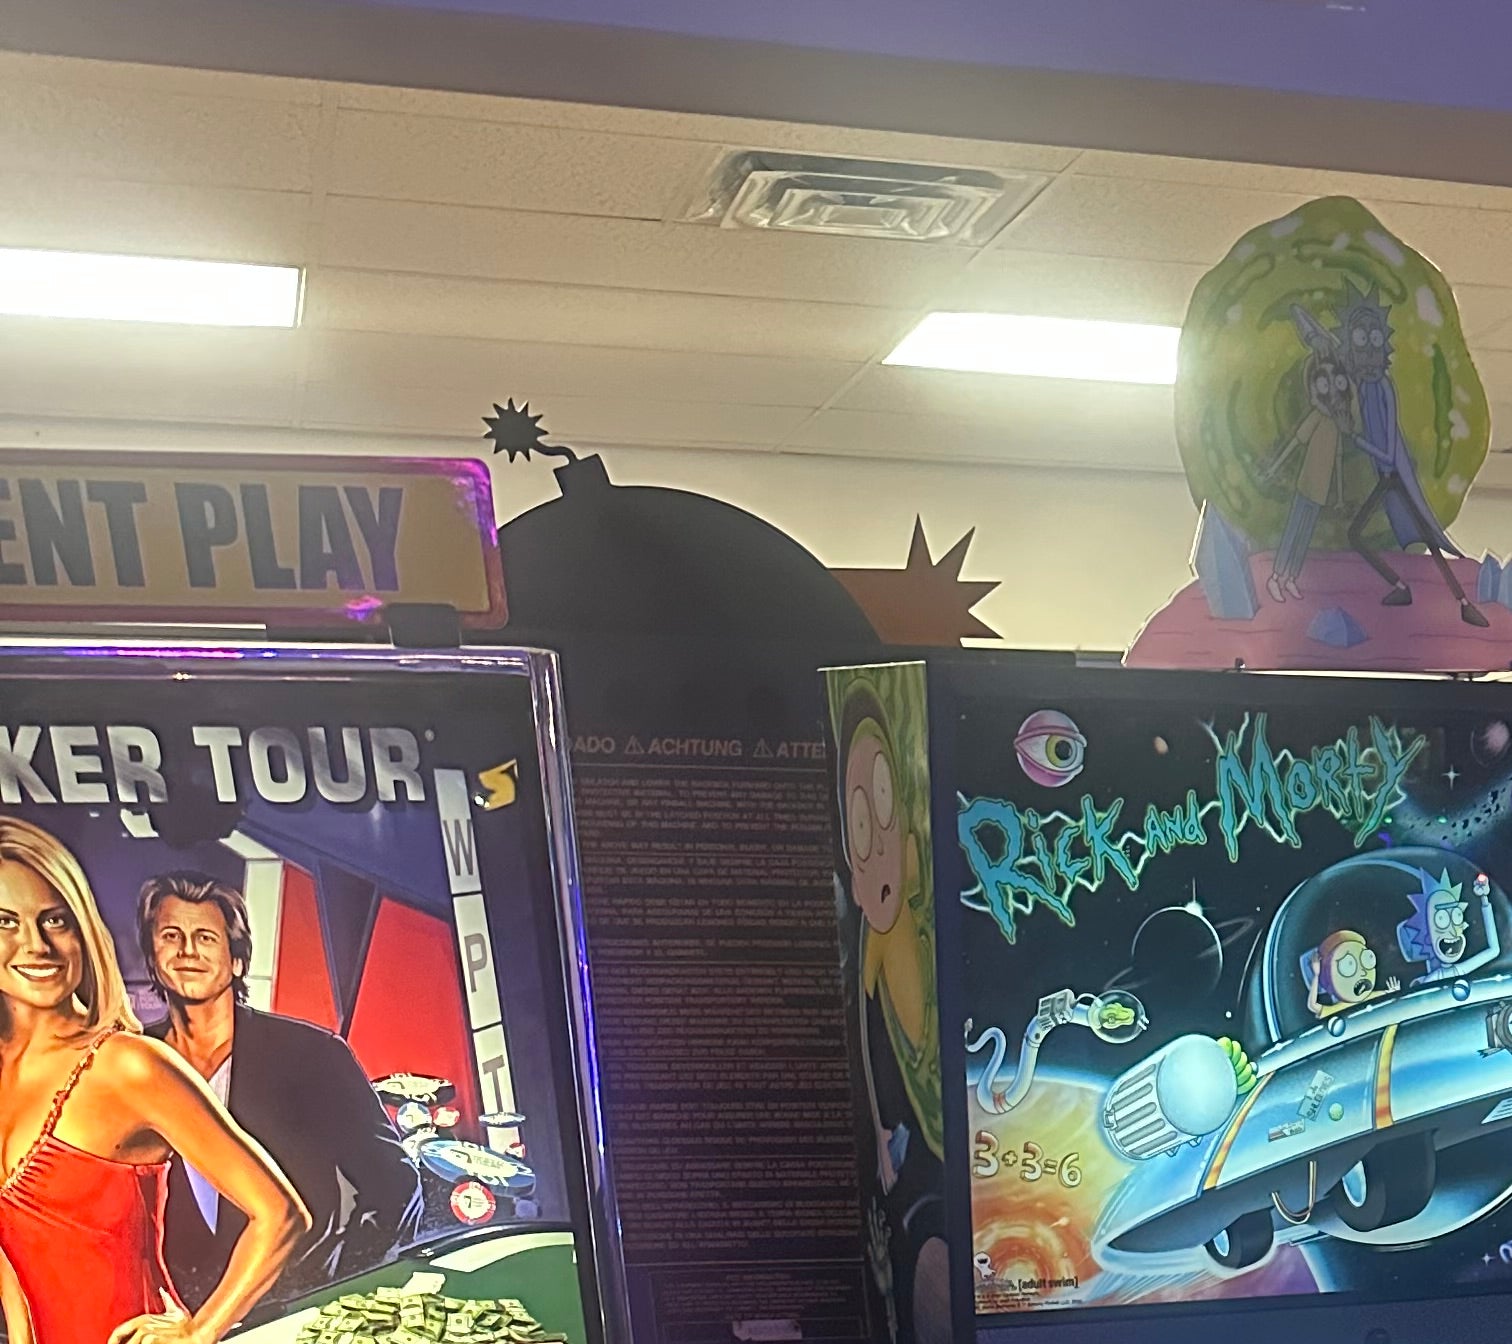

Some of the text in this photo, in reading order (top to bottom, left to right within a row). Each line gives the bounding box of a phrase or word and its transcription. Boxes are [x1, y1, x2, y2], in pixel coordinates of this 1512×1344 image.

[175, 481, 403, 592] PLAY
[193, 726, 425, 803] TOUR
[648, 738, 743, 757] ACHTUNG
